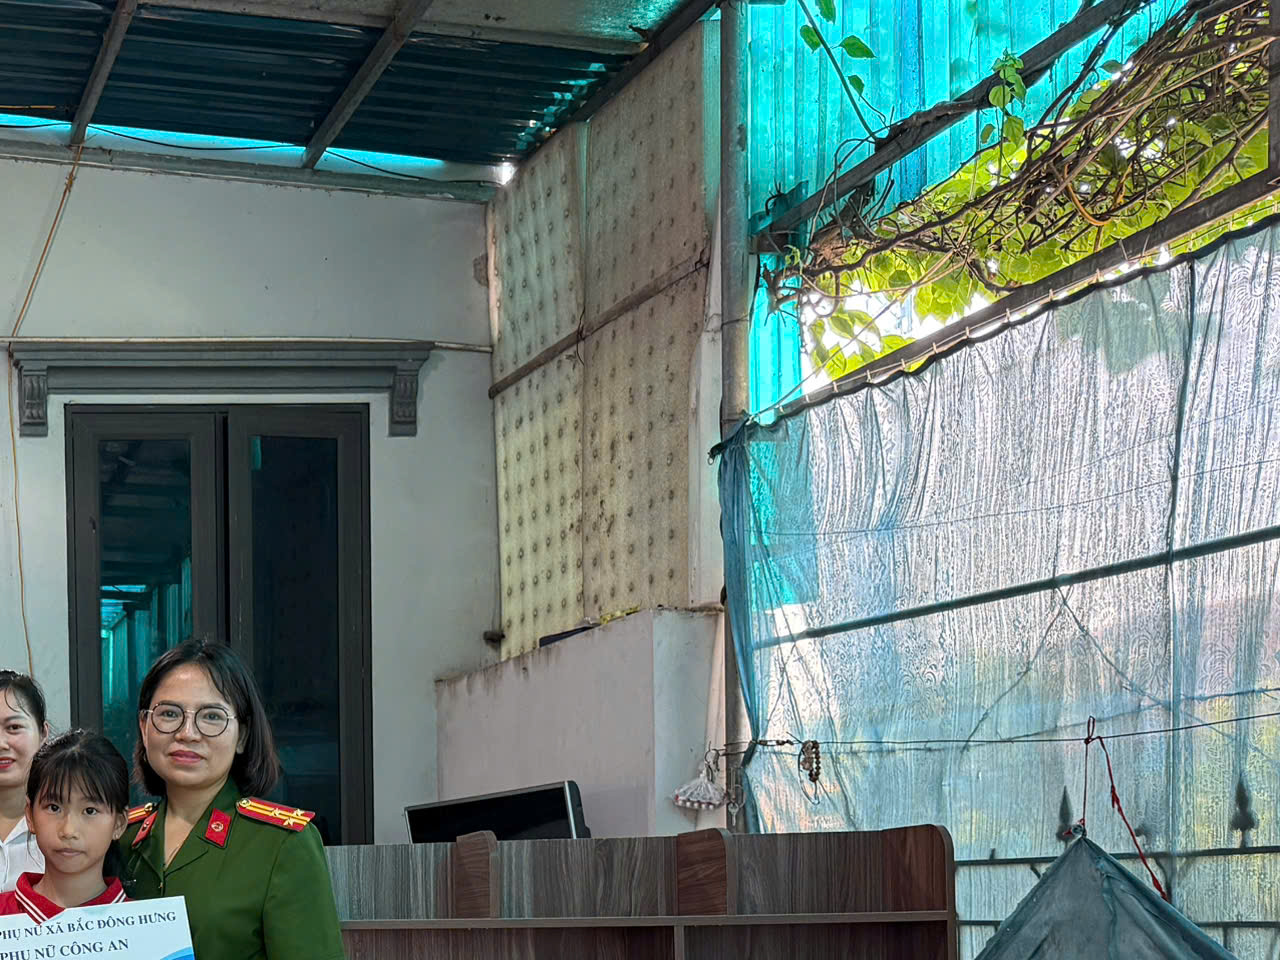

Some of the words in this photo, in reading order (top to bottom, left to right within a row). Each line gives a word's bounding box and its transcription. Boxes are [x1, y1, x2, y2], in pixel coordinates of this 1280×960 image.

[46, 922, 64, 935] XÃ
[67, 917, 94, 933] BẮC
[97, 916, 135, 929] ĐÔNG
[138, 911, 176, 925] HƯNG
[34, 944, 56, 959] NỮ
[60, 941, 103, 956] CÔNG
[108, 939, 129, 951] AN
